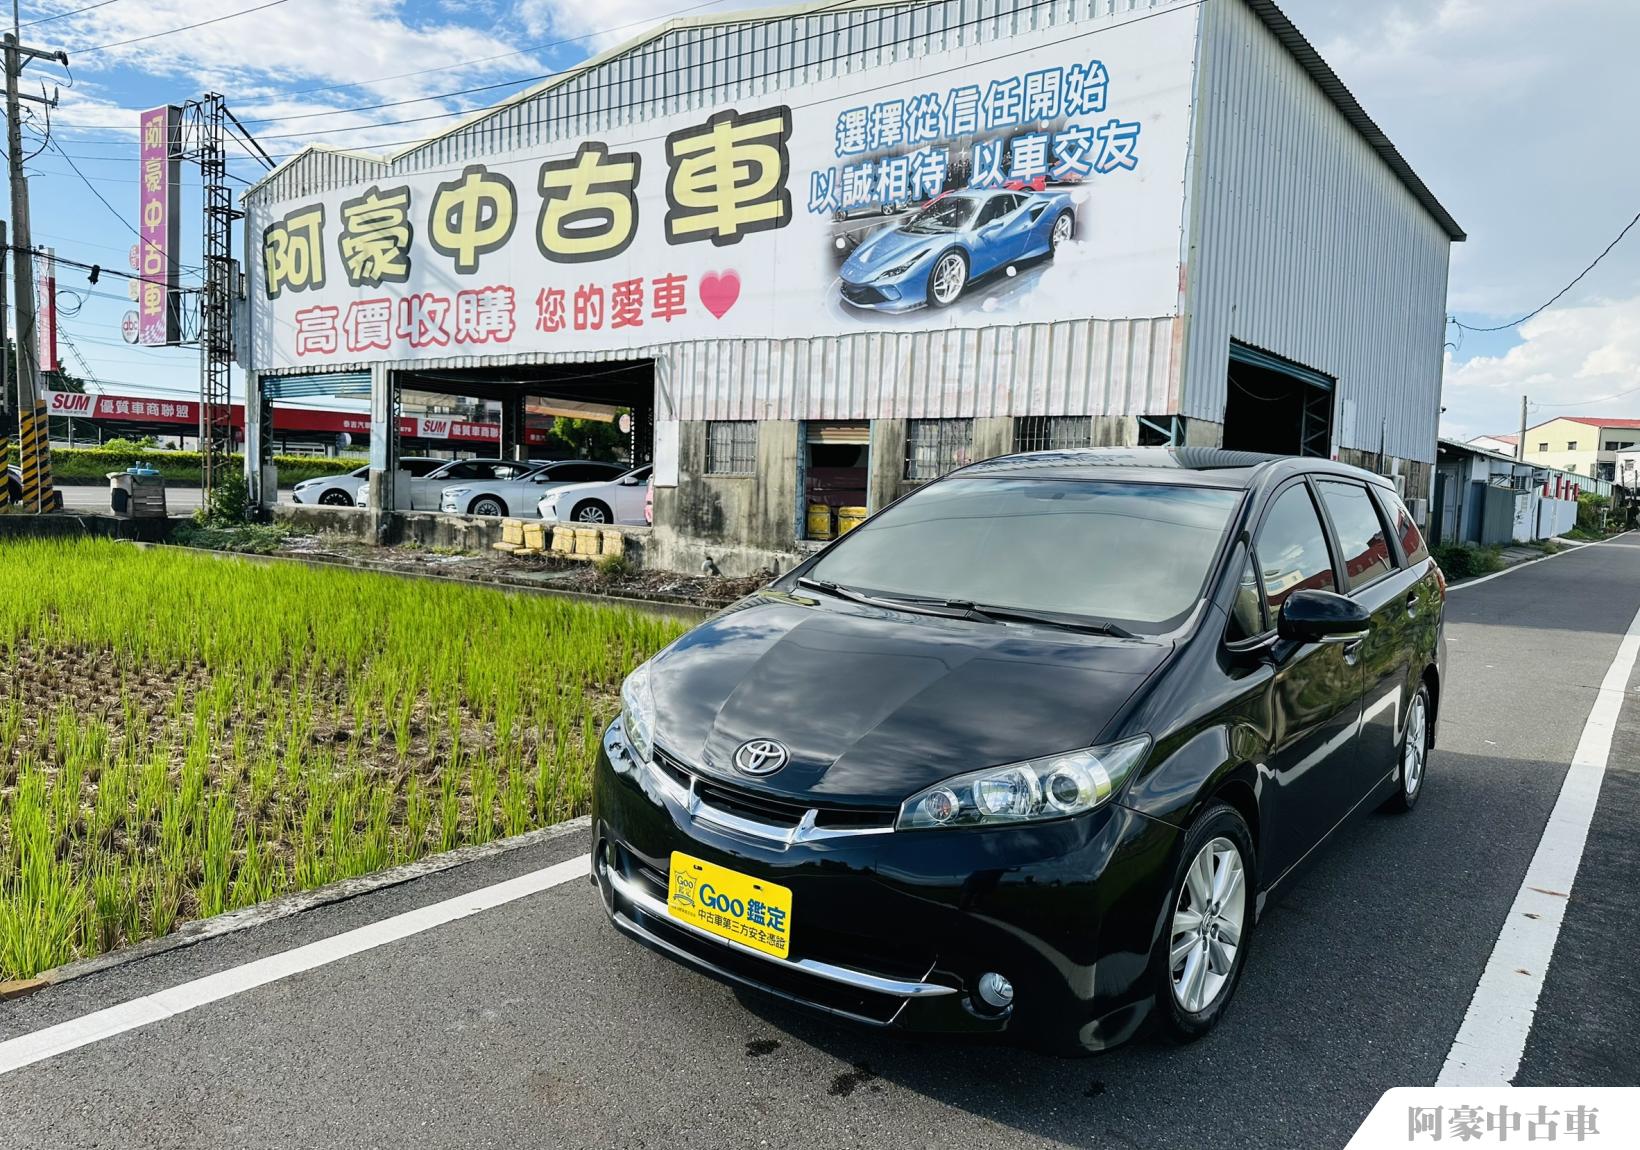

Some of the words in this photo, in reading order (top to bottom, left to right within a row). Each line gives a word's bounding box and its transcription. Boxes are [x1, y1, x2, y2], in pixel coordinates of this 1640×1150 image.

[835, 60, 1109, 157] 選擇從信任開始
[808, 147, 948, 214] 以誠相待
[968, 119, 1140, 190] 以車交友
[144, 115, 163, 316] 阿豪中古車
[264, 105, 792, 299] 阿豪中古車
[295, 285, 516, 356] 高價收購
[535, 273, 689, 333] 您的愛車
[52, 394, 91, 410] SUM
[100, 399, 189, 418] 優質車商聯盟
[422, 420, 446, 432] SUM
[677, 875, 693, 888] Goo
[699, 883, 745, 917] Goo
[747, 898, 786, 933] 鑑定
